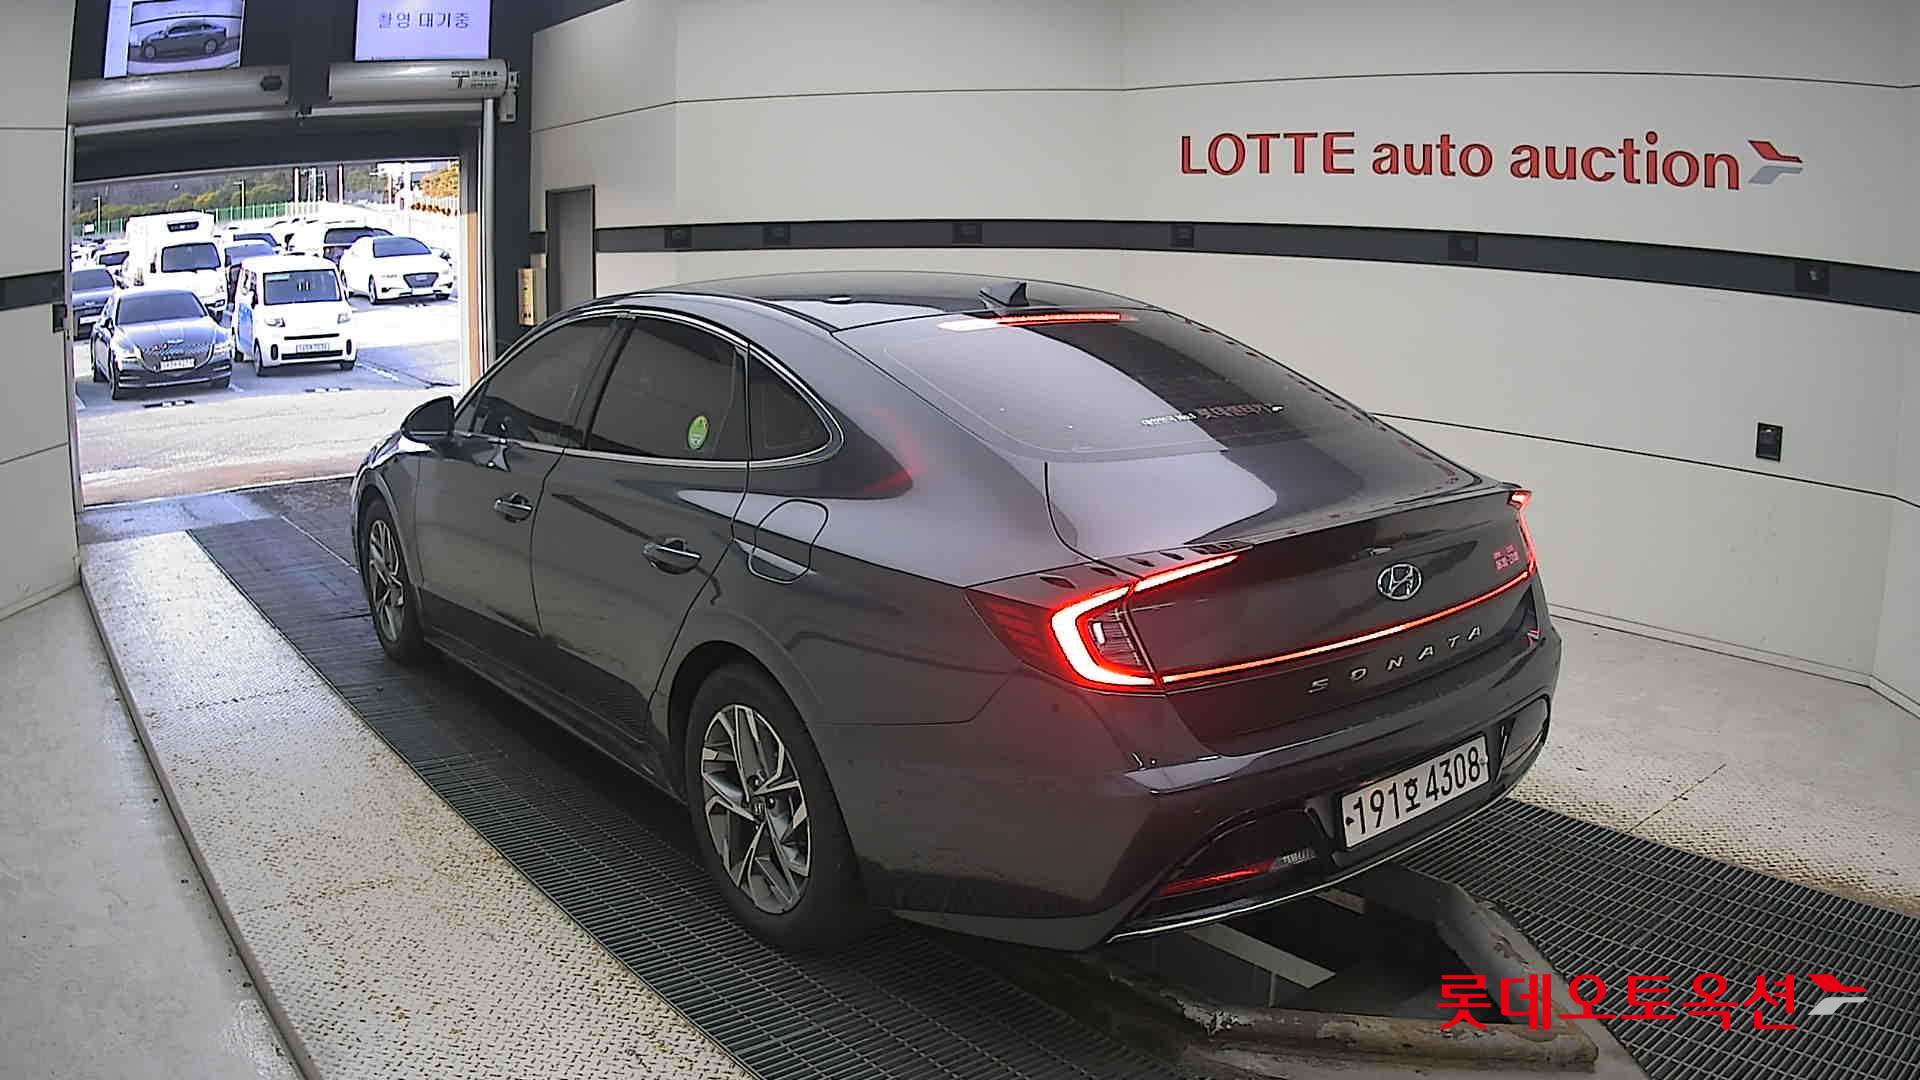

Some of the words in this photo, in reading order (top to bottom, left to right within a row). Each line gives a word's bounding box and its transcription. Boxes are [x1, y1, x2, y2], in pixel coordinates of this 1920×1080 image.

[419, 12, 470, 29] 대기중
[1180, 131, 1355, 176] LOTTE
[1372, 133, 1493, 178] auto
[1510, 130, 1740, 191] auction
[1307, 625, 1482, 693] SONATA
